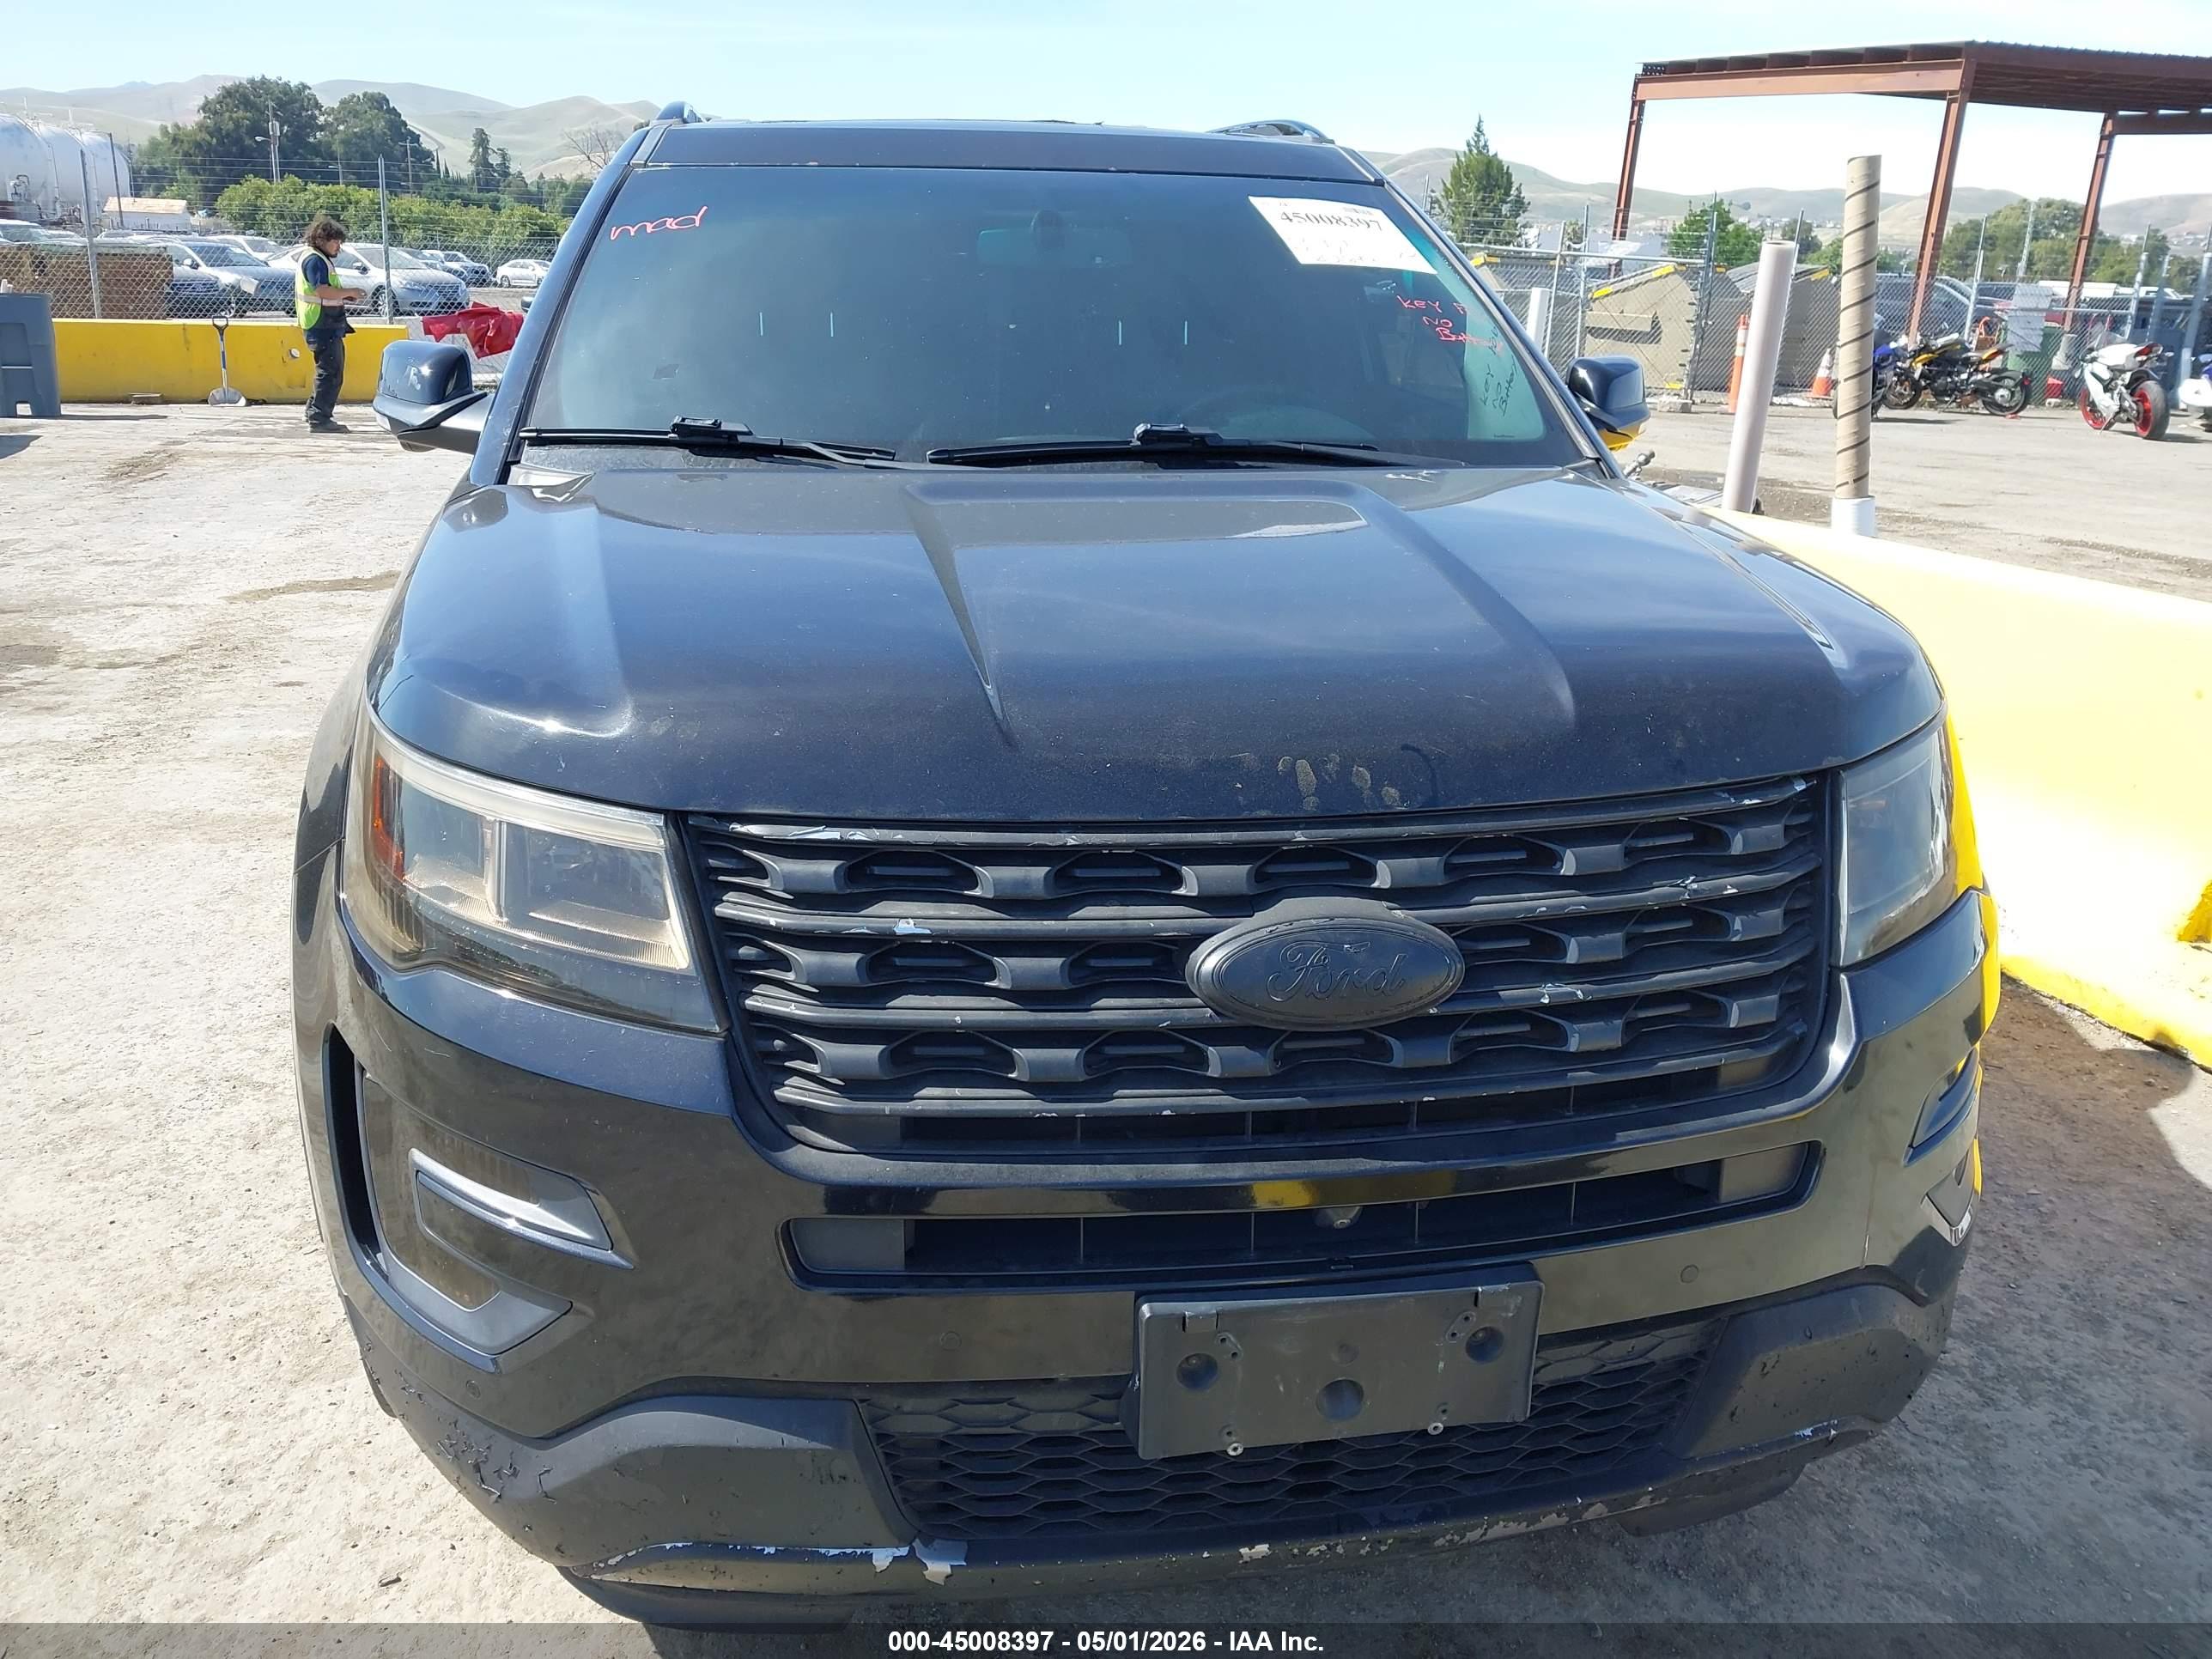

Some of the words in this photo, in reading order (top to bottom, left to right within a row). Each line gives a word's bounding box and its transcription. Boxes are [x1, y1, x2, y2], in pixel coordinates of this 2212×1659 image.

[610, 204, 708, 240] mad
[1279, 210, 1383, 231] 45008397
[1396, 295, 1443, 313] KEY
[1422, 316, 1453, 328] NO
[1266, 940, 1409, 1002] Ford
